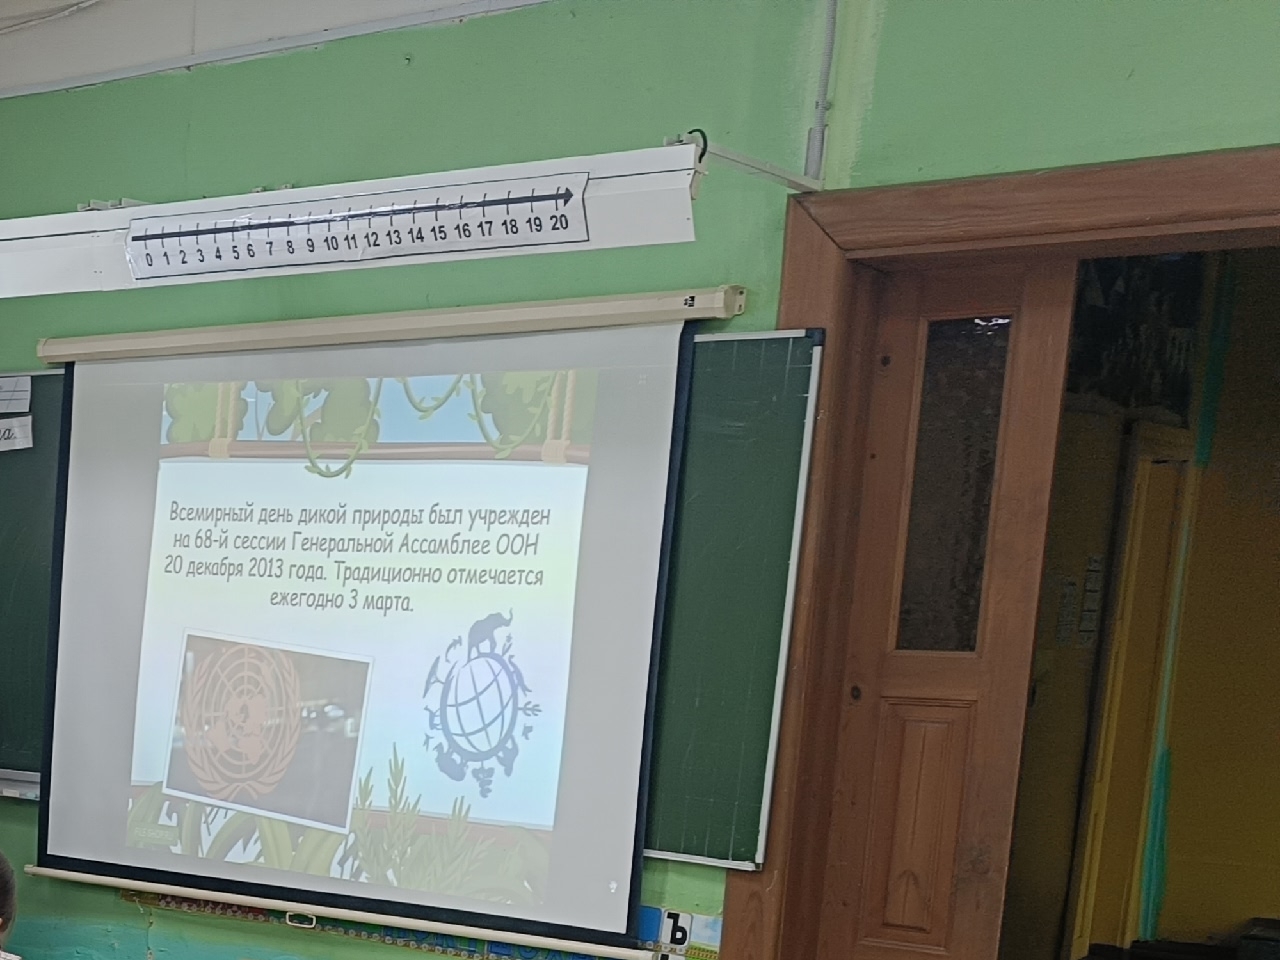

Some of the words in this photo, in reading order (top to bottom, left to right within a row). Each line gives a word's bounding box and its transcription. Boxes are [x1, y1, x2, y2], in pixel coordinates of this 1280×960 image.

[145, 253, 153, 267] 0
[162, 252, 170, 265] 1
[179, 250, 188, 264] 2
[197, 248, 205, 263] 3
[214, 247, 222, 261] 4
[232, 245, 240, 260] 5
[247, 244, 255, 258] 6
[265, 242, 274, 256] 7
[286, 240, 295, 254] 8
[306, 238, 315, 252] 9
[324, 236, 339, 251] 10
[344, 234, 358, 250] 11
[364, 232, 380, 248] 12
[386, 229, 402, 245] 13
[407, 227, 425, 244] 14
[430, 225, 447, 242] 15
[454, 222, 471, 239] 16
[477, 220, 493, 237] 17
[501, 219, 519, 235] 18
[526, 216, 542, 233] 19
[549, 214, 569, 231] 20
[169, 500, 254, 527] Всемирный
[257, 507, 293, 525] день
[297, 502, 347, 526] дикой
[352, 508, 424, 531] природы
[428, 502, 463, 525] был
[468, 509, 551, 532] учрежден
[173, 532, 190, 548] на
[194, 528, 228, 549] 68-й
[233, 534, 286, 551] сессии
[291, 531, 393, 558] Генеральной
[398, 532, 491, 555] Ассамблее
[496, 532, 540, 556] ООН
[164, 554, 183, 574] 20
[186, 556, 244, 582] декабря
[248, 557, 284, 578] 2013
[288, 564, 327, 582] года.
[334, 560, 442, 587] Традиционно
[446, 567, 544, 586] отмечается
[270, 591, 344, 611] ежегодно
[348, 588, 358, 609] 3
[362, 594, 414, 617] марта.
[666, 911, 688, 946] Ъ
